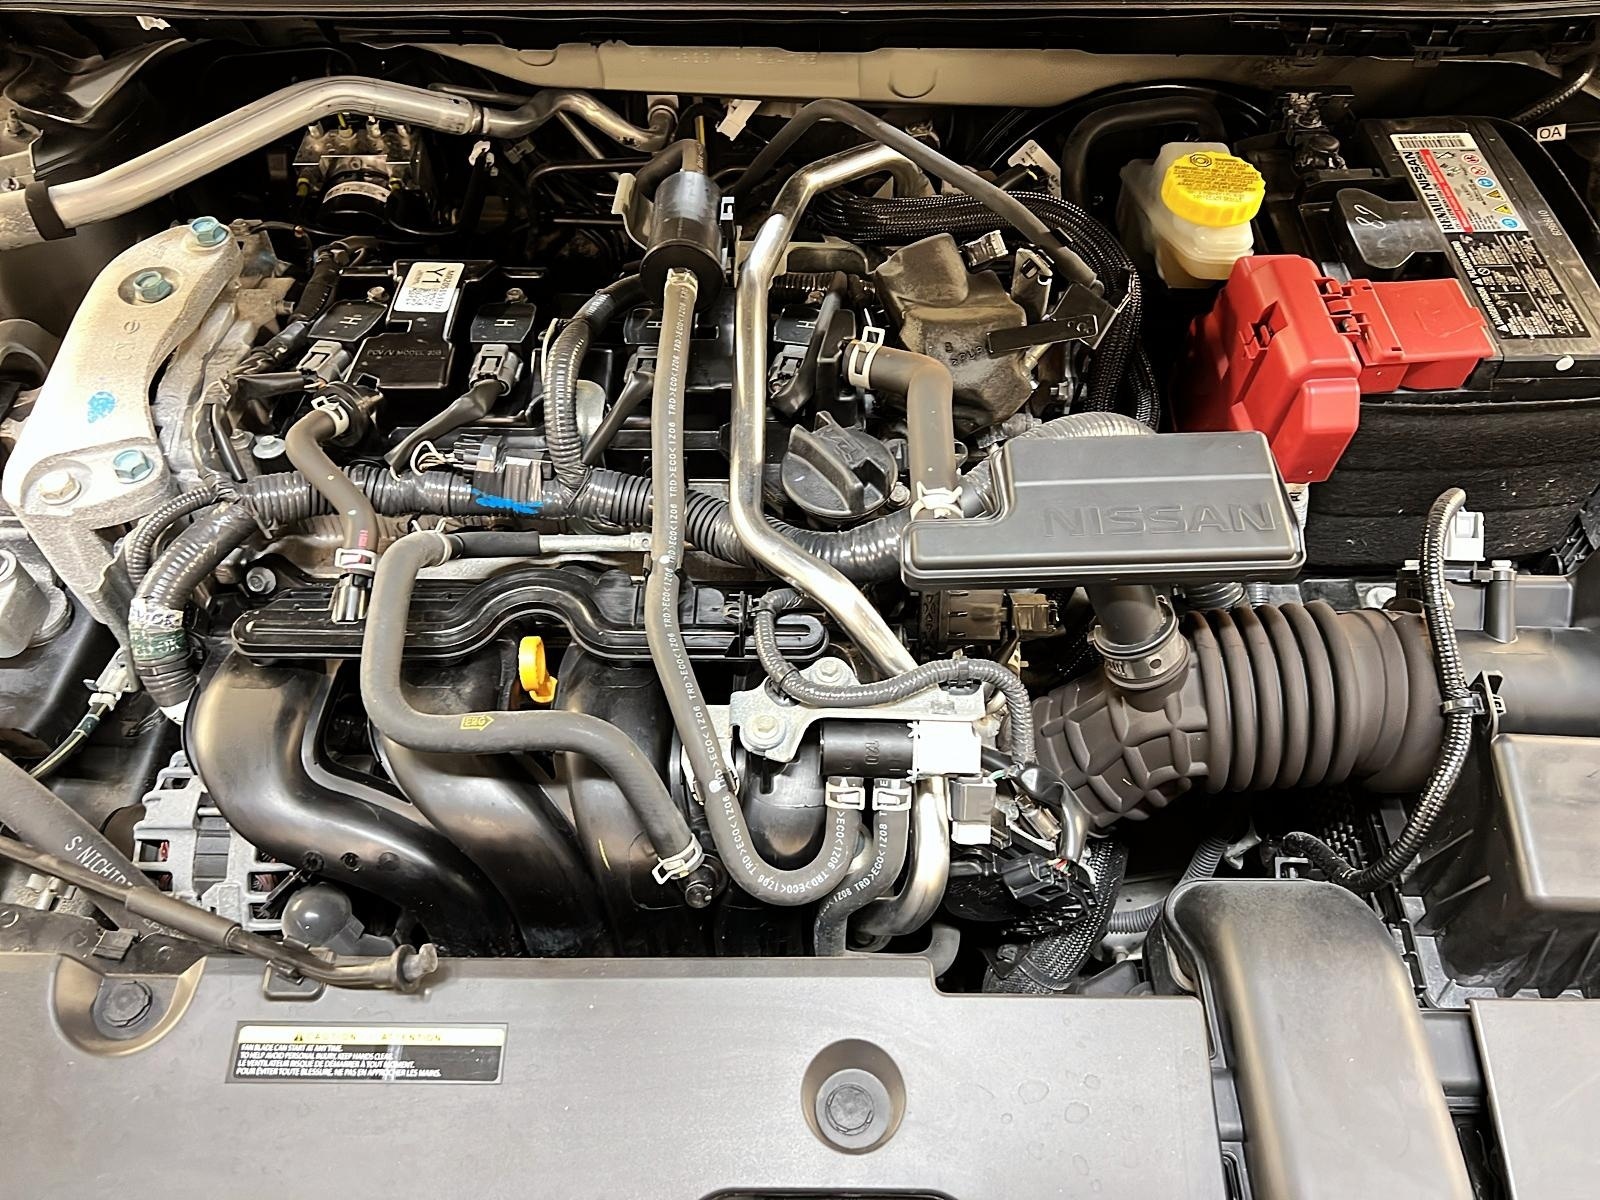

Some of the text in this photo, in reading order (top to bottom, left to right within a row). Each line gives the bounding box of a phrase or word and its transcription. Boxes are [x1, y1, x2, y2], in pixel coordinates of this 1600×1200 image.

[1540, 126, 1562, 139] OA
[1403, 151, 1433, 190] NISSAN
[1426, 192, 1455, 231] RENAULT
[421, 267, 448, 284] Y1
[1044, 502, 1277, 538] NISSAN
